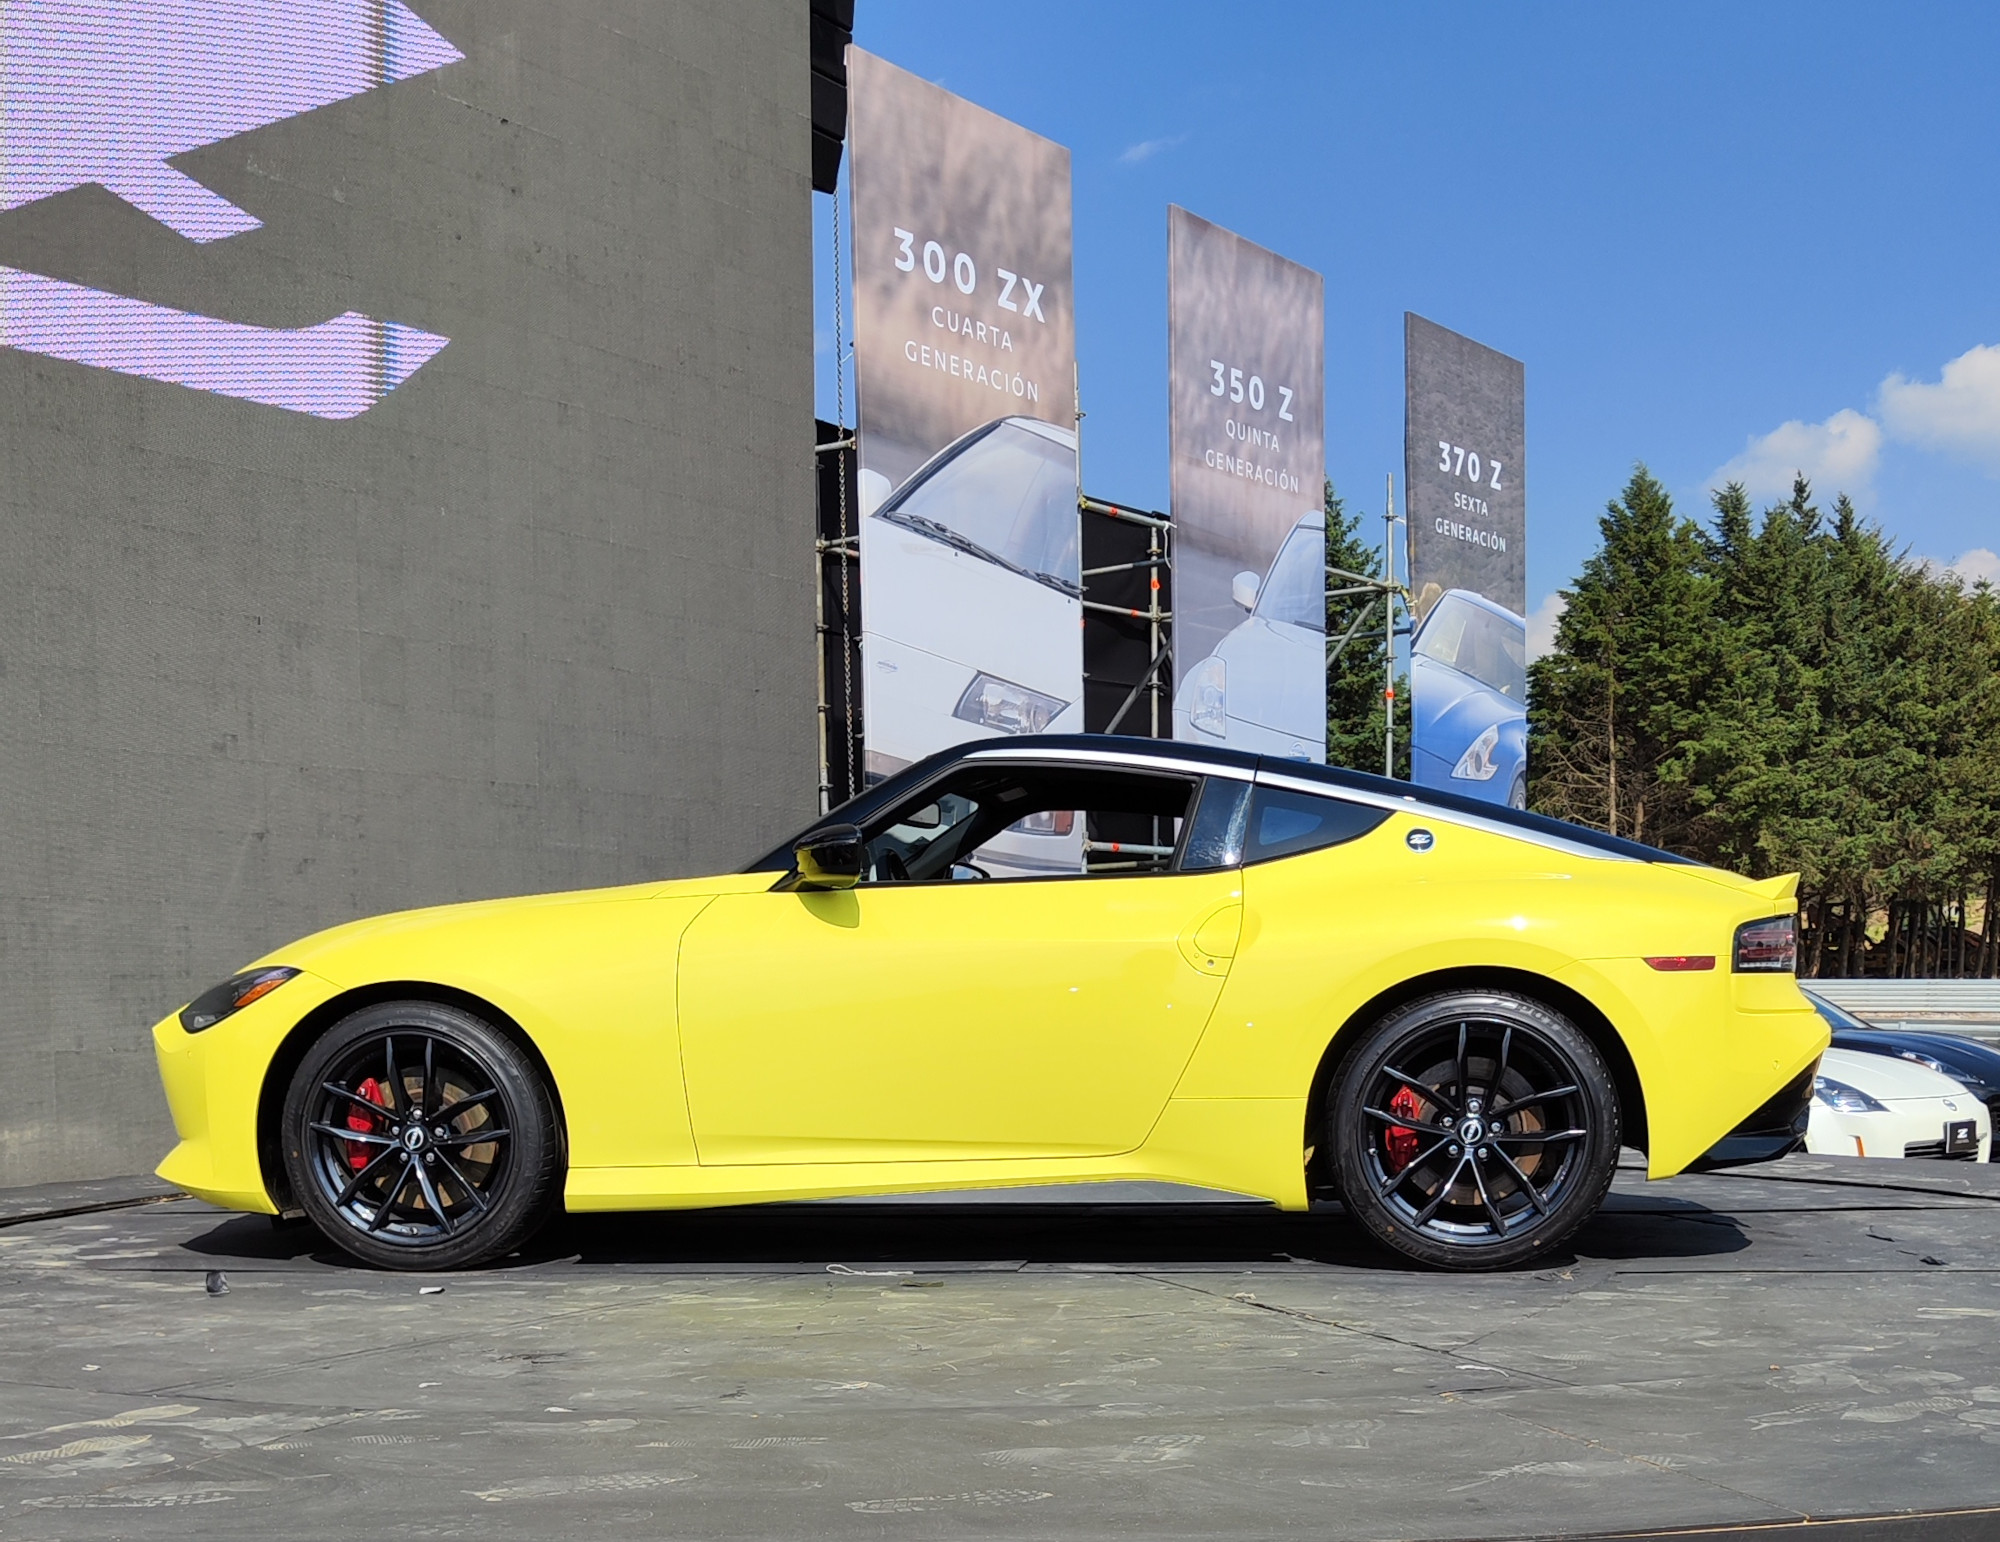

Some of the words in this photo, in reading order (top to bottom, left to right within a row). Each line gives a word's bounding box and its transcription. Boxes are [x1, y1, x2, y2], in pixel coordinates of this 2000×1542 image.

[894, 227, 976, 295] 300
[997, 267, 1046, 324] ZX
[931, 306, 1013, 353] CUARTA
[904, 340, 1039, 403] GENERACIÓN
[1210, 359, 1265, 411] 350
[1278, 386, 1294, 422] Z
[1225, 419, 1280, 453] QUINTA
[1205, 449, 1299, 494] GENERACIÓN
[1438, 440, 1481, 483] 370
[1490, 459, 1502, 491] Z
[1454, 491, 1489, 517] SEXTA
[1435, 517, 1507, 553] GENERACIÓN
